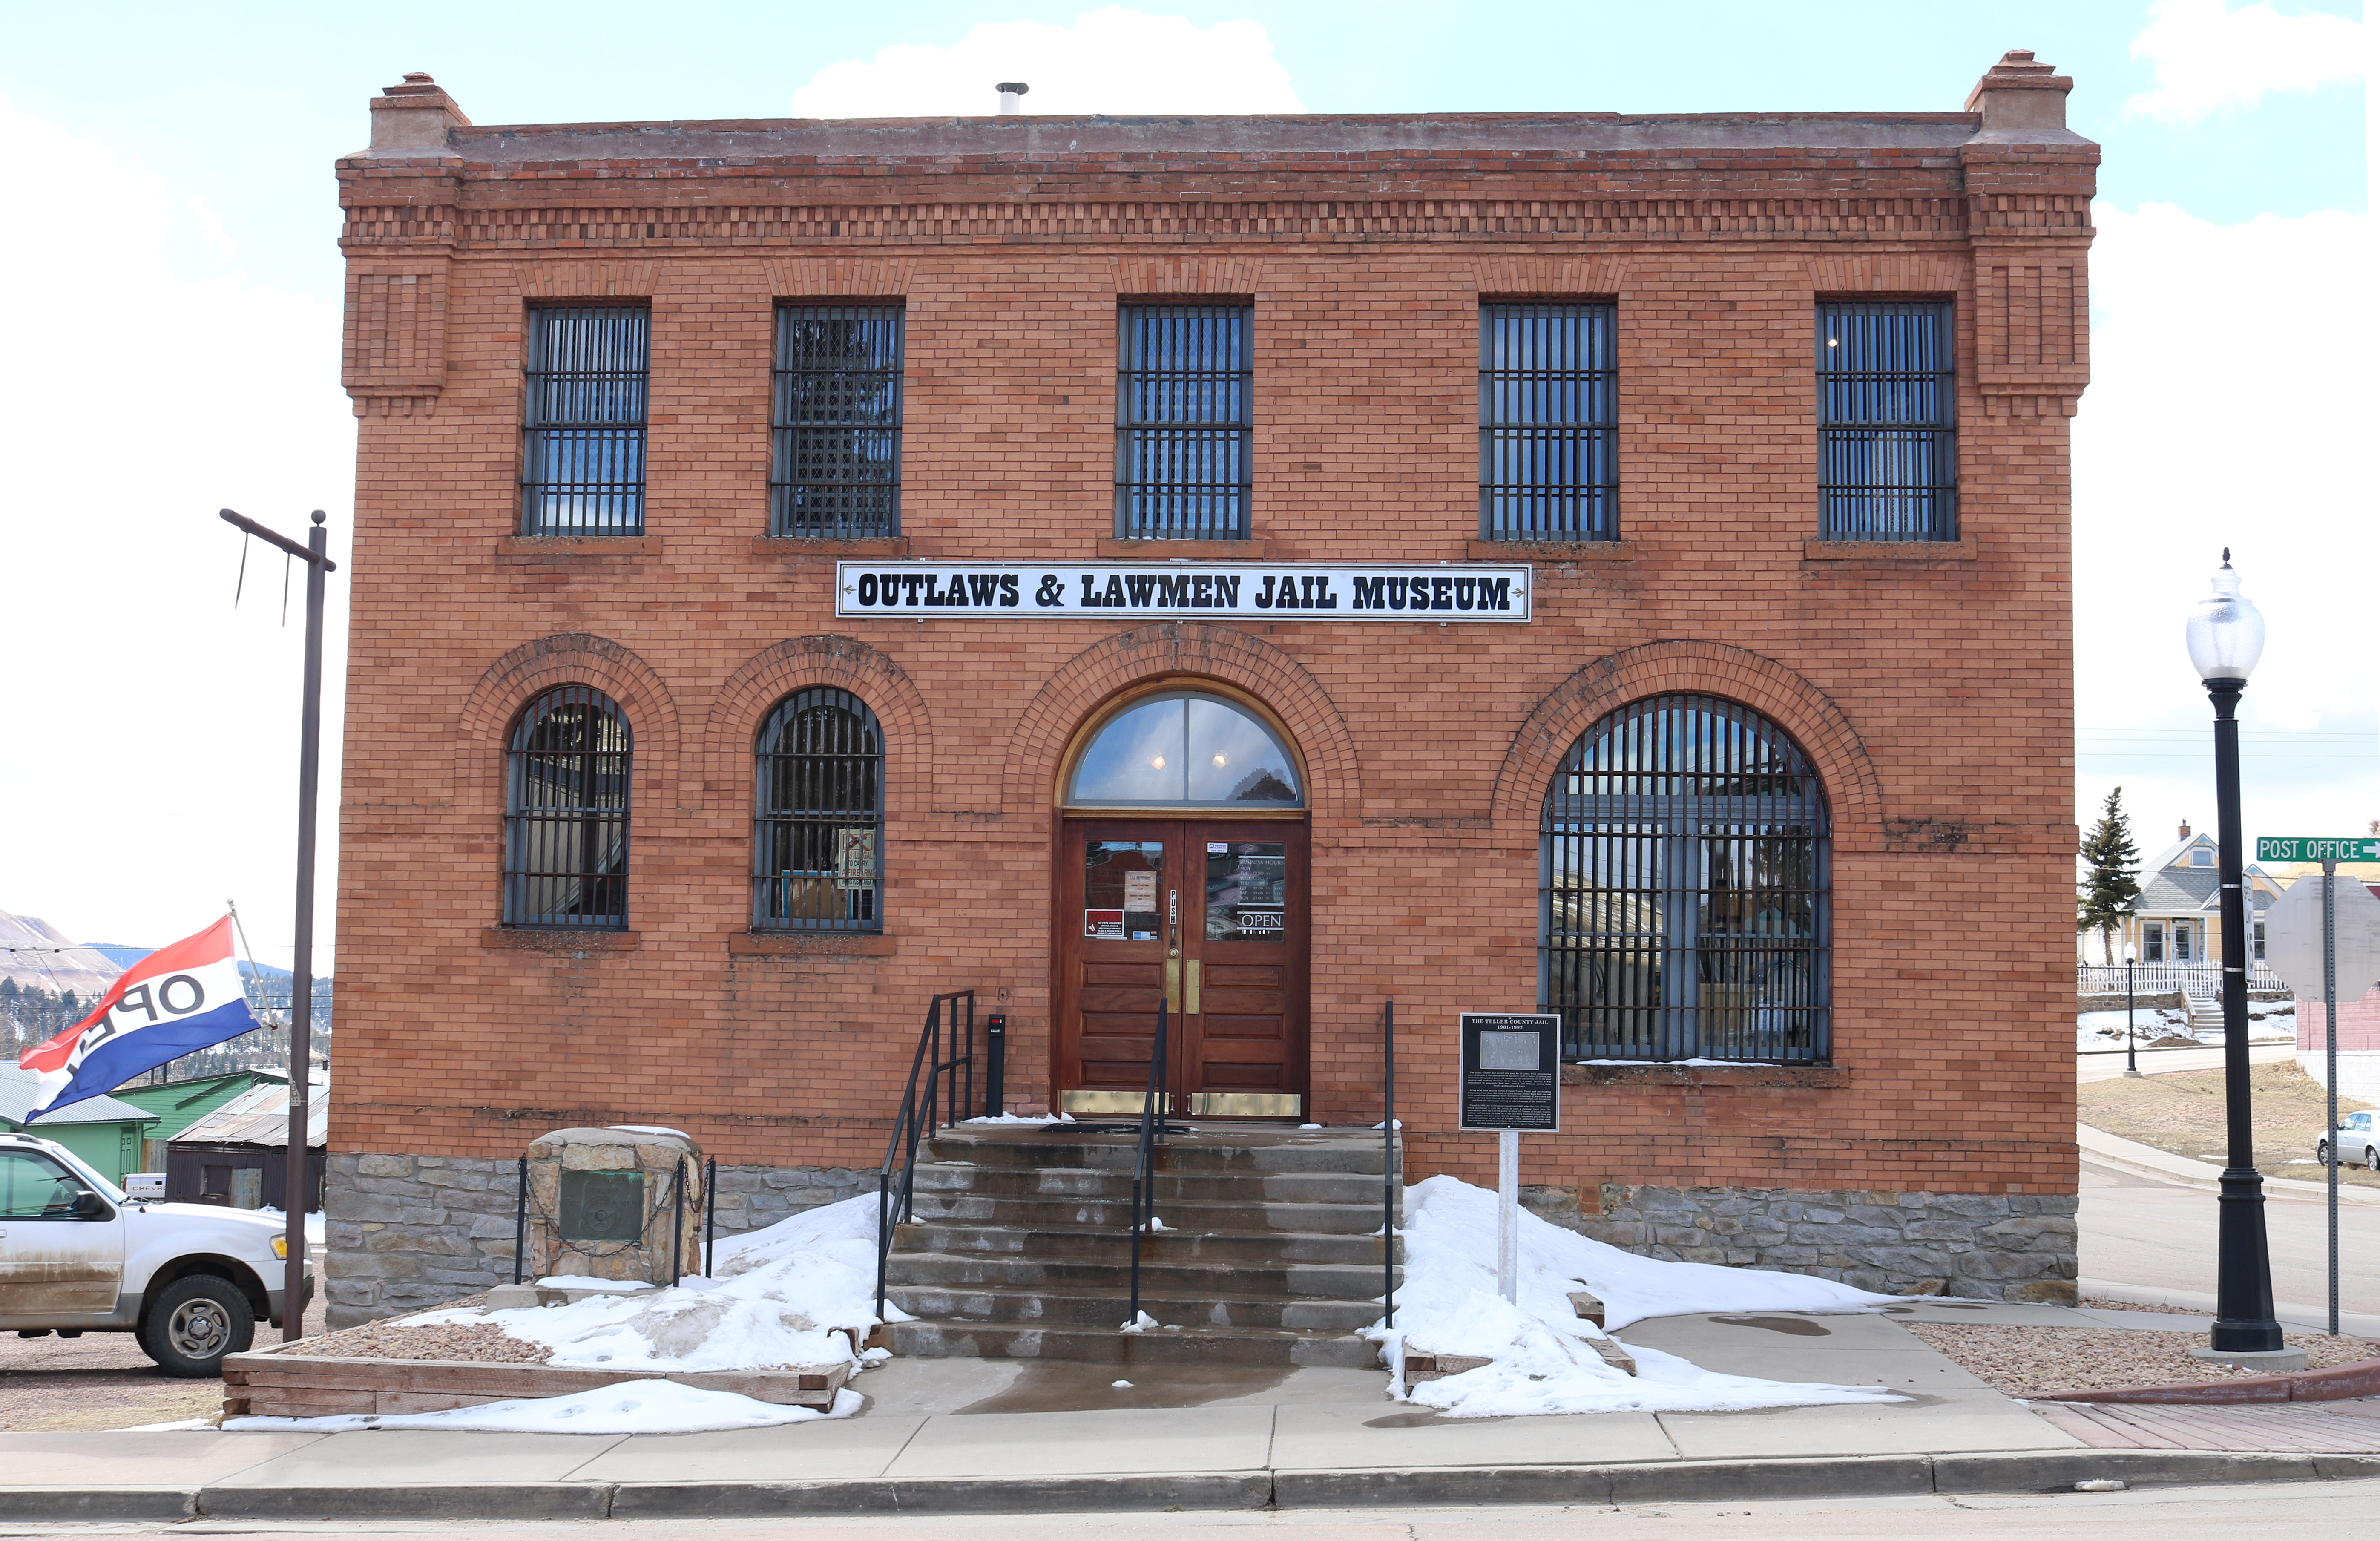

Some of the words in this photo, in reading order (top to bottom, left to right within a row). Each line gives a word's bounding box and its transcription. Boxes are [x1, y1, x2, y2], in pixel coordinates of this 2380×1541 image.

[858, 573, 1019, 607] OUTLAWS
[1035, 574, 1065, 607] &
[1081, 575, 1240, 608] LAWMEN
[1255, 576, 1337, 609] JAIL
[1353, 576, 1510, 610] MUSEUM
[2260, 840, 2299, 858] POST
[2306, 840, 2360, 859] OFFICE
[1242, 915, 1281, 927] OPEN
